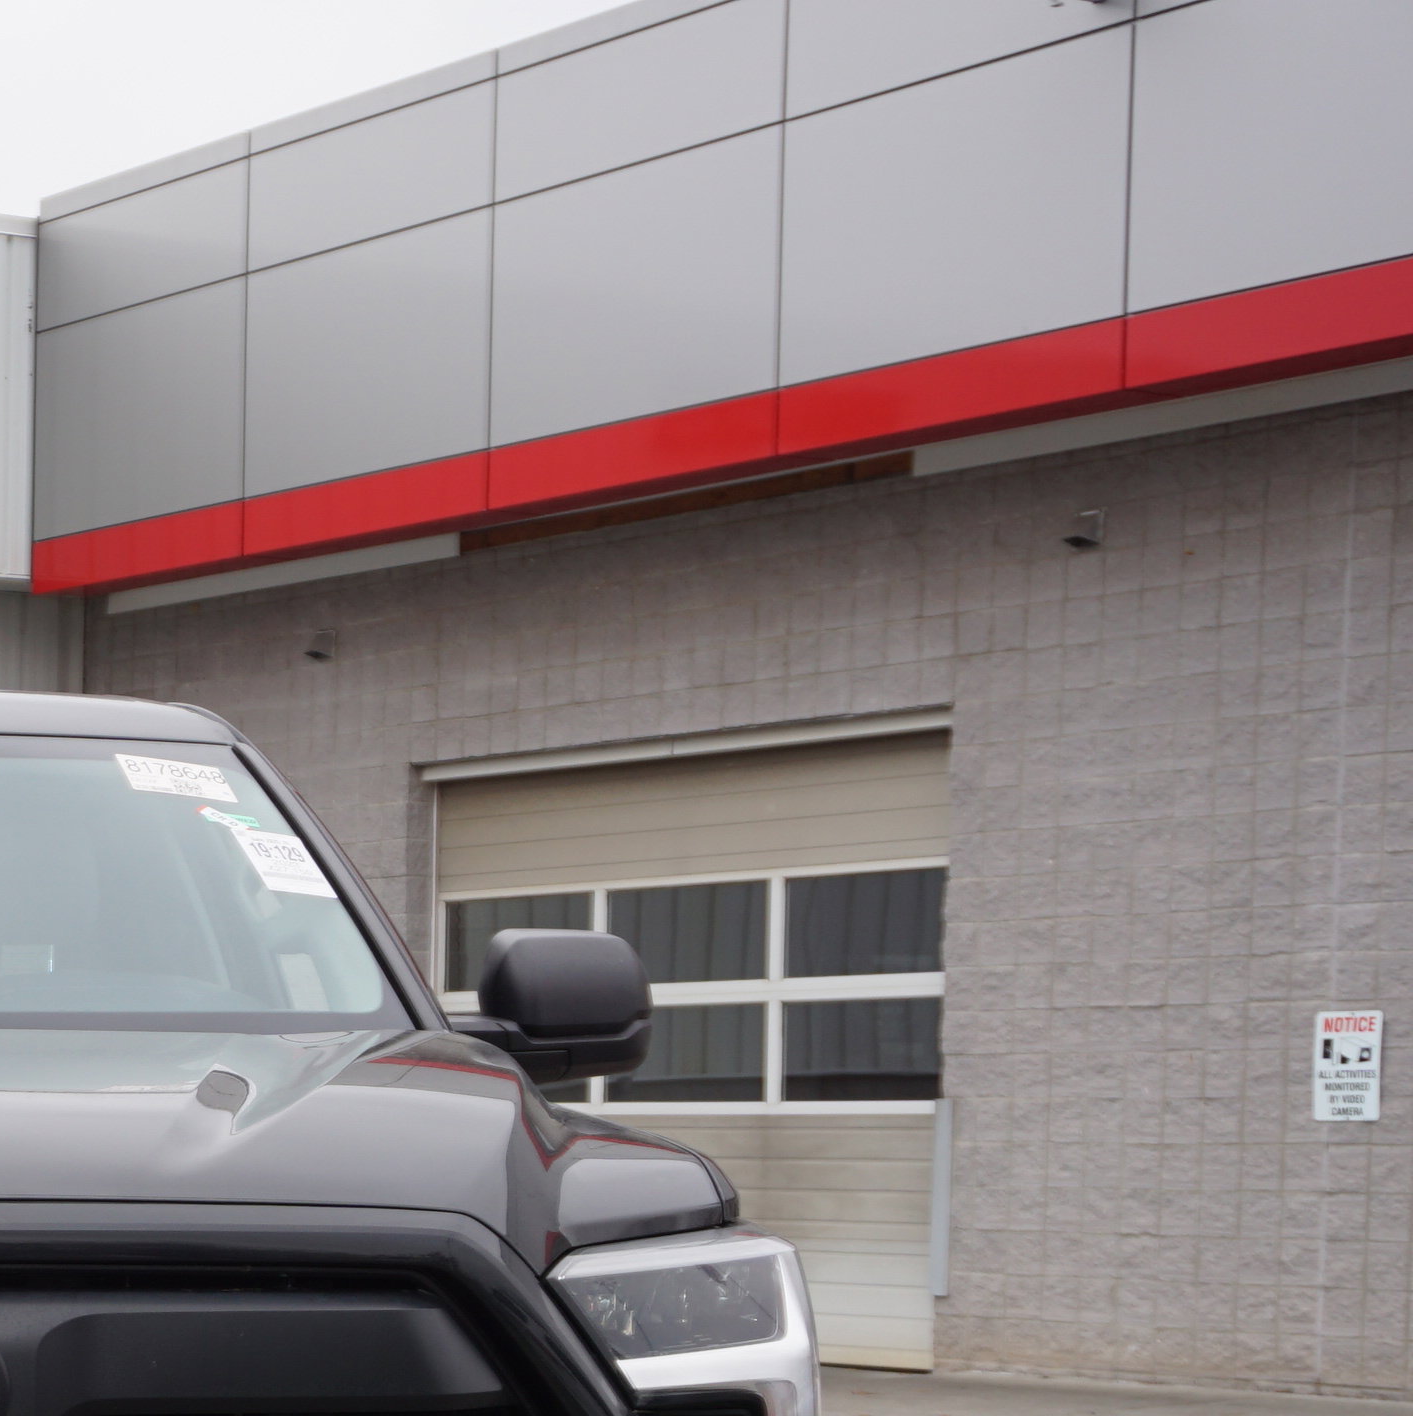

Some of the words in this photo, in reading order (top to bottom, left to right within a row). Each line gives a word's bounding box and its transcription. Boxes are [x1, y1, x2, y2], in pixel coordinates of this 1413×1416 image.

[124, 758, 226, 785] 8178648
[1324, 1016, 1377, 1033] NOTICE
[1318, 1070, 1332, 1079] ALL
[1334, 1069, 1377, 1079] ACTIVITIES
[1324, 1082, 1370, 1092] MONITORED
[1329, 1094, 1339, 1104] BY
[1342, 1094, 1365, 1104] VIDEO
[1331, 1107, 1364, 1117] CAMERA
